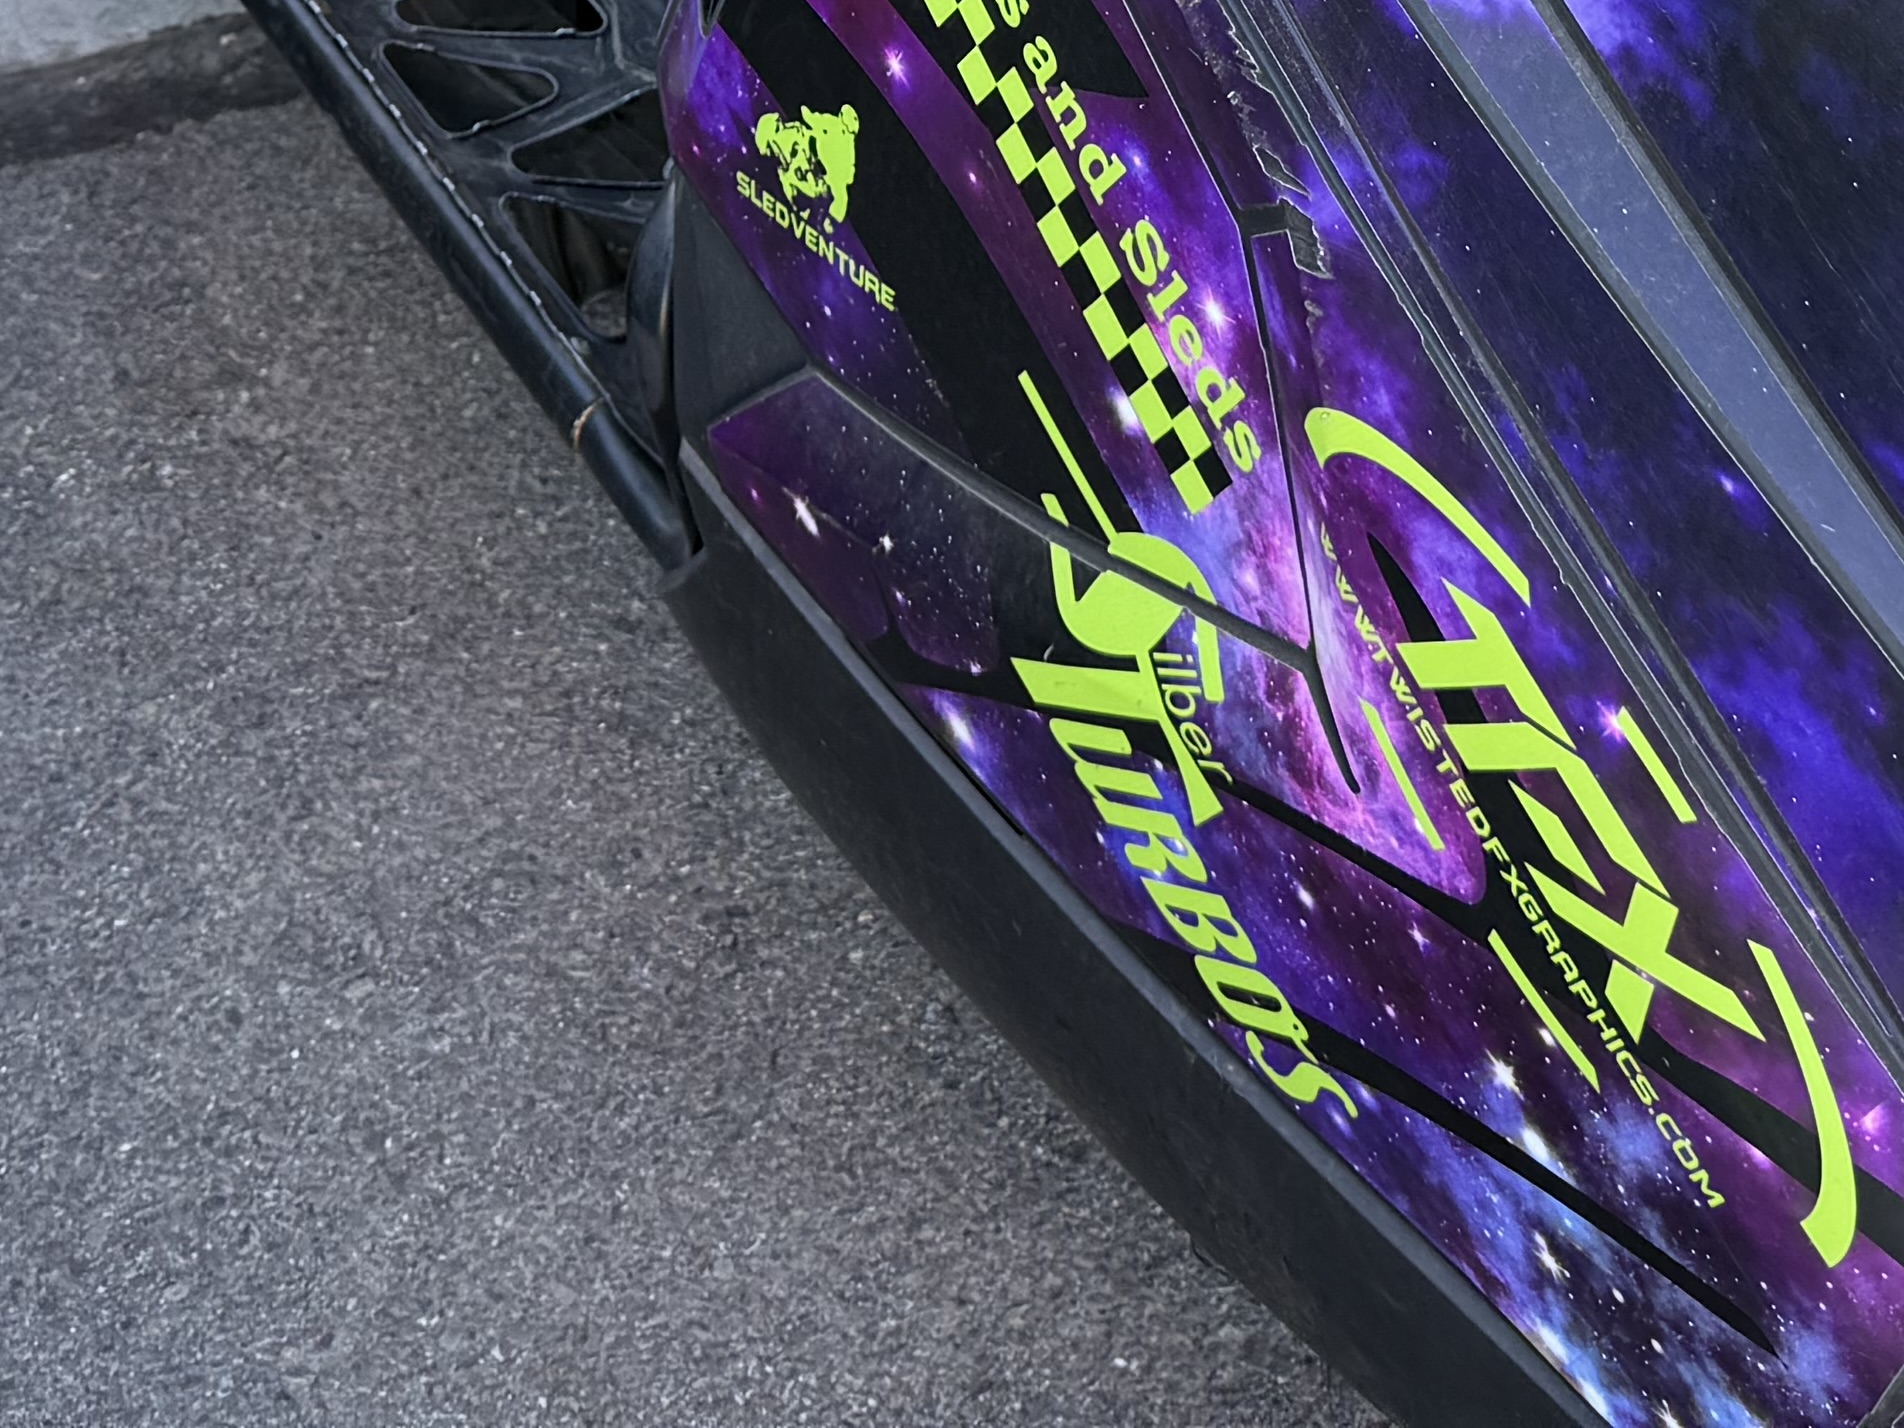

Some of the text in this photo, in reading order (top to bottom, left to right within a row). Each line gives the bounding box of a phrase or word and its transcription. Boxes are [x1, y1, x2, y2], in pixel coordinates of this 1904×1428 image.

[736, 171, 895, 312] SLEDVENTURE
[1023, 36, 1126, 205] and
[1120, 220, 1262, 473] Sleds
